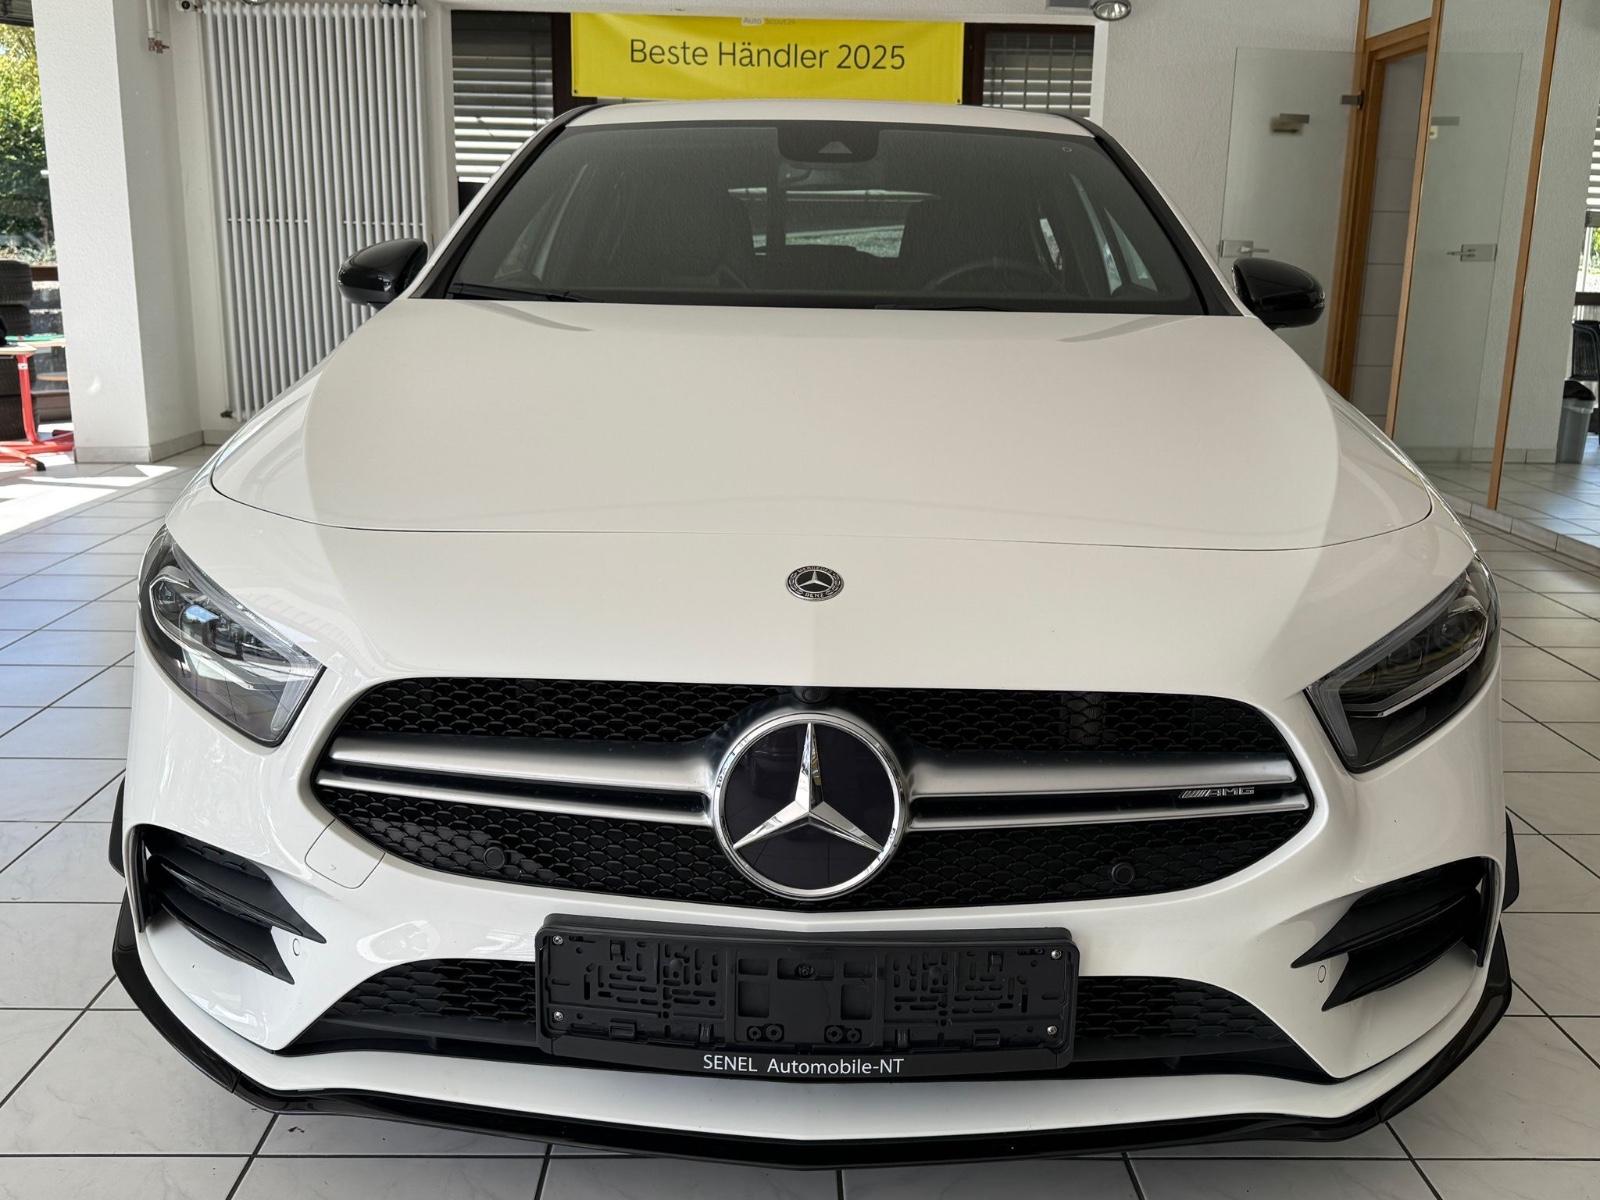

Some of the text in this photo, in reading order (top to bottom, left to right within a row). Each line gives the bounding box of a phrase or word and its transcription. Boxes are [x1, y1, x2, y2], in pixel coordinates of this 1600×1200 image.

[630, 39, 905, 70] Beste Händler 2025
[703, 1054, 905, 1075] SENEL Automobile-NT
